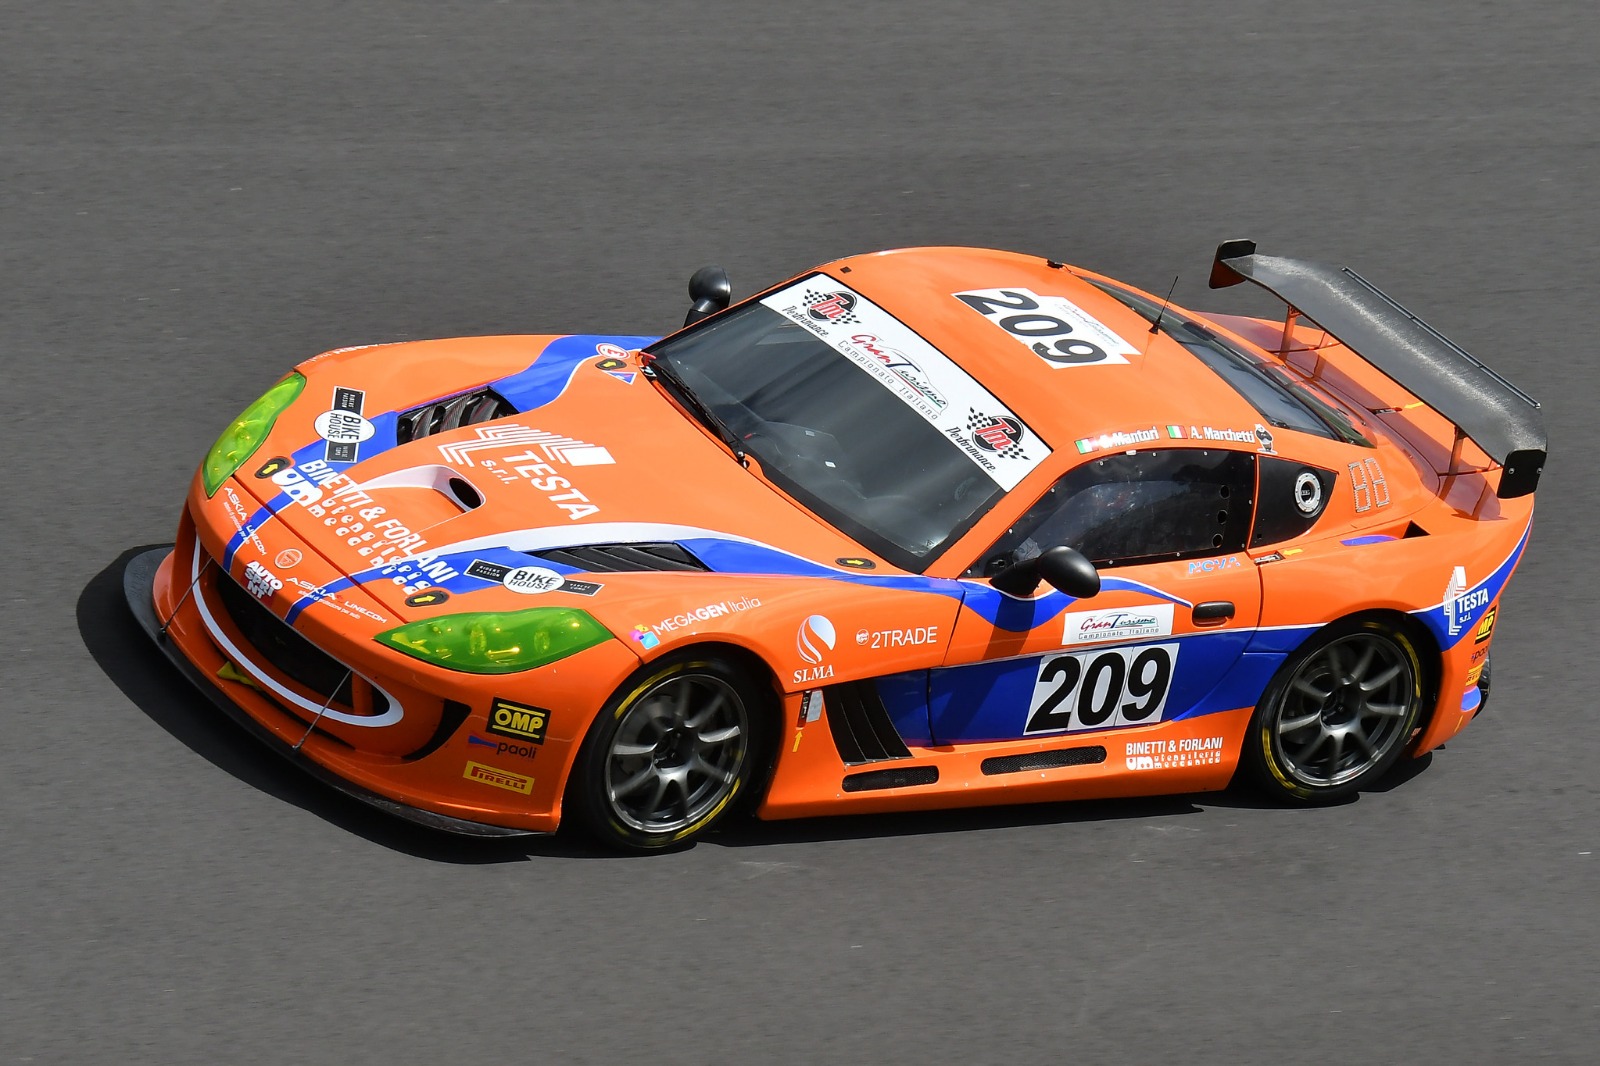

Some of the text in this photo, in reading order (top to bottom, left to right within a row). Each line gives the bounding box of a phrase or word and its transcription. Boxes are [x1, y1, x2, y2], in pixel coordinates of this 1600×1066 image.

[955, 290, 1107, 363] 209
[838, 340, 938, 420] Campionato Italiano
[327, 412, 343, 439] HOUSE
[340, 415, 361, 440] BIKE
[1190, 425, 1256, 443] A. Marchetti
[481, 459, 518, 485] s.r.l.
[502, 450, 600, 520] TESTA
[223, 487, 247, 521] ASKIA
[298, 459, 459, 584] BINETTI & FORLANI
[307, 504, 419, 595] meccanica
[246, 561, 283, 590] AUTO
[508, 579, 554, 591] HOUSE
[513, 569, 560, 586] BIKE
[285, 577, 387, 623] ASKIA LINE.COM
[1458, 588, 1489, 614] TESTA
[652, 596, 762, 636] MEGAGEN Italia
[871, 626, 938, 649] 2TRADE
[1078, 628, 1160, 640] Campionato Italiano
[793, 664, 835, 684] SI.MA
[1025, 648, 1171, 732] 209
[495, 709, 543, 732] OMP
[496, 742, 537, 759] paoli
[1126, 737, 1223, 756] BINETTI & FORLANI
[1154, 757, 1220, 769] meccanica
[471, 766, 527, 790] PIRELLI
